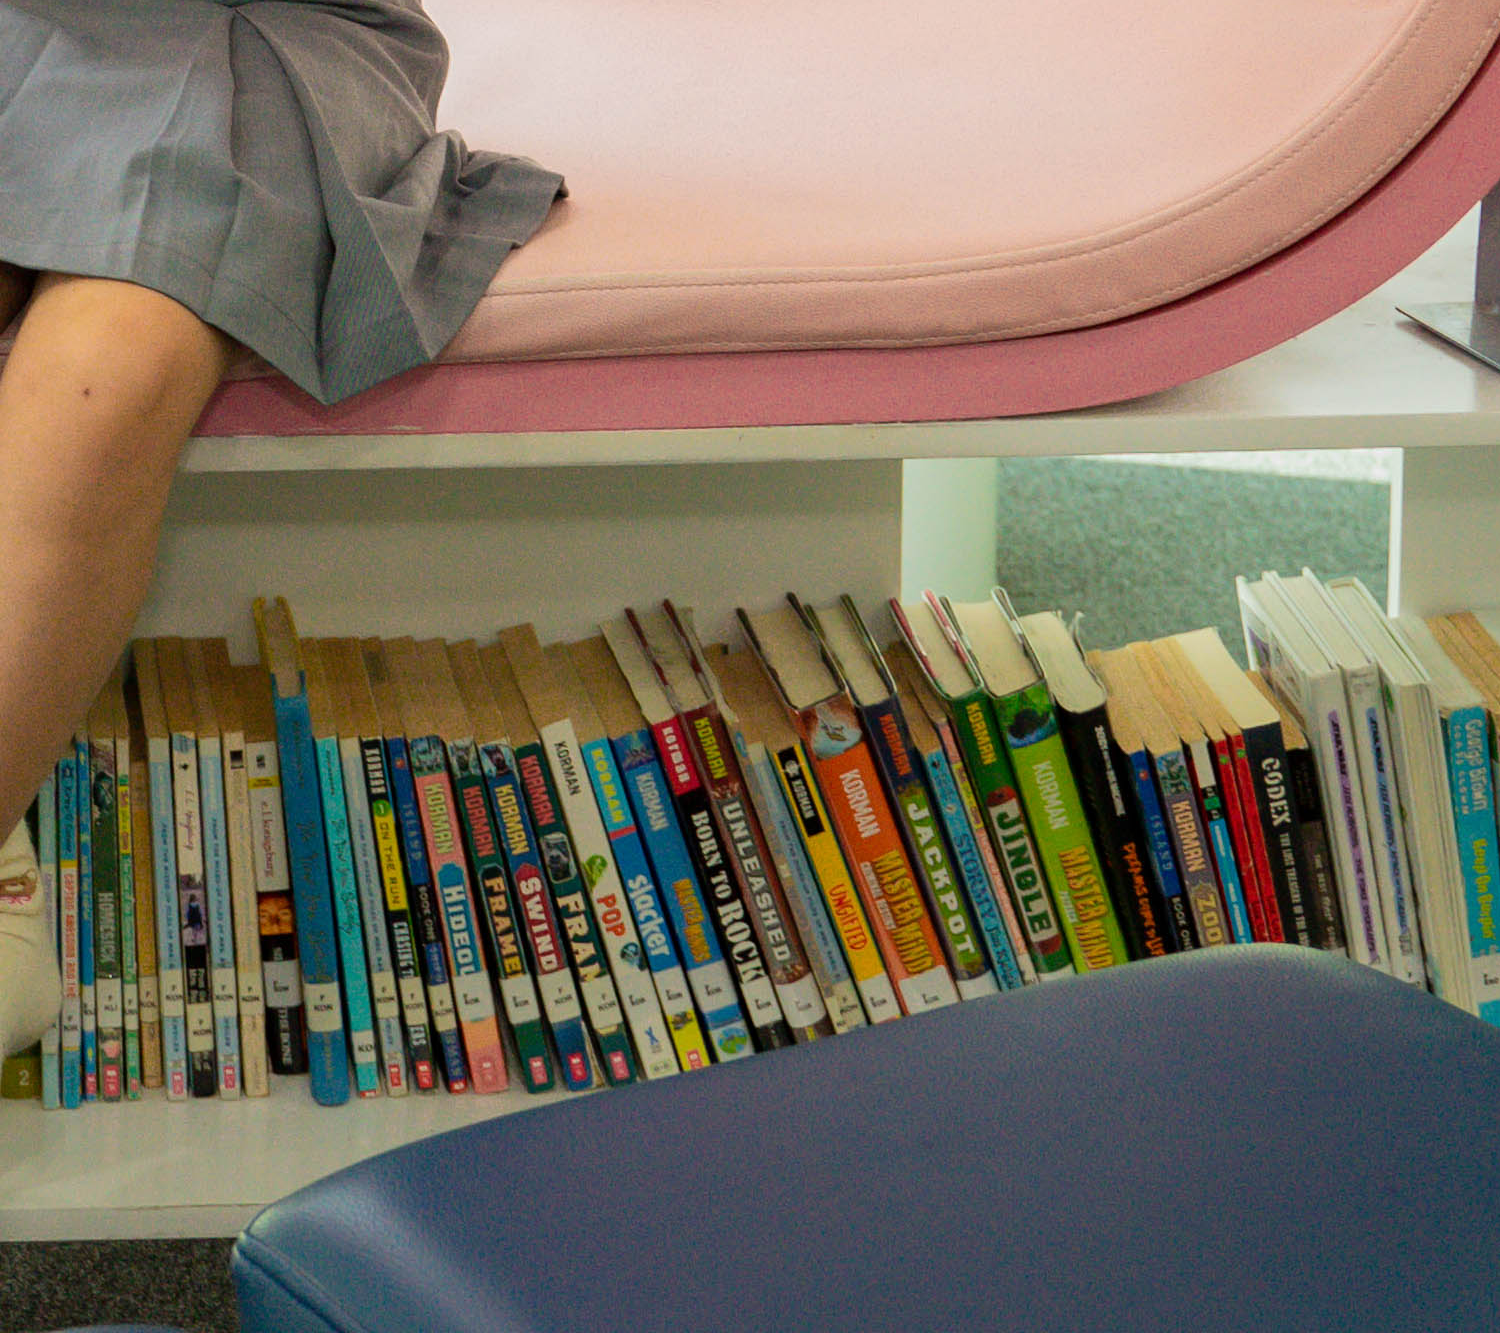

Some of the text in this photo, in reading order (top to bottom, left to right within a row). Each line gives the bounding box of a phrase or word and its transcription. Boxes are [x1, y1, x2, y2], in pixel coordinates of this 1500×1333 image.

[554, 741, 581, 797] KORMAN
[839, 768, 881, 839] KORMAN
[1260, 757, 1292, 829] CODEX
[423, 781, 453, 856] KORMAN
[693, 812, 765, 985] BORN TO ROCK
[723, 802, 790, 963] UNLEASHED
[907, 802, 973, 959] JACKPOT
[996, 807, 1048, 934] JINGLE
[596, 894, 626, 937] POP
